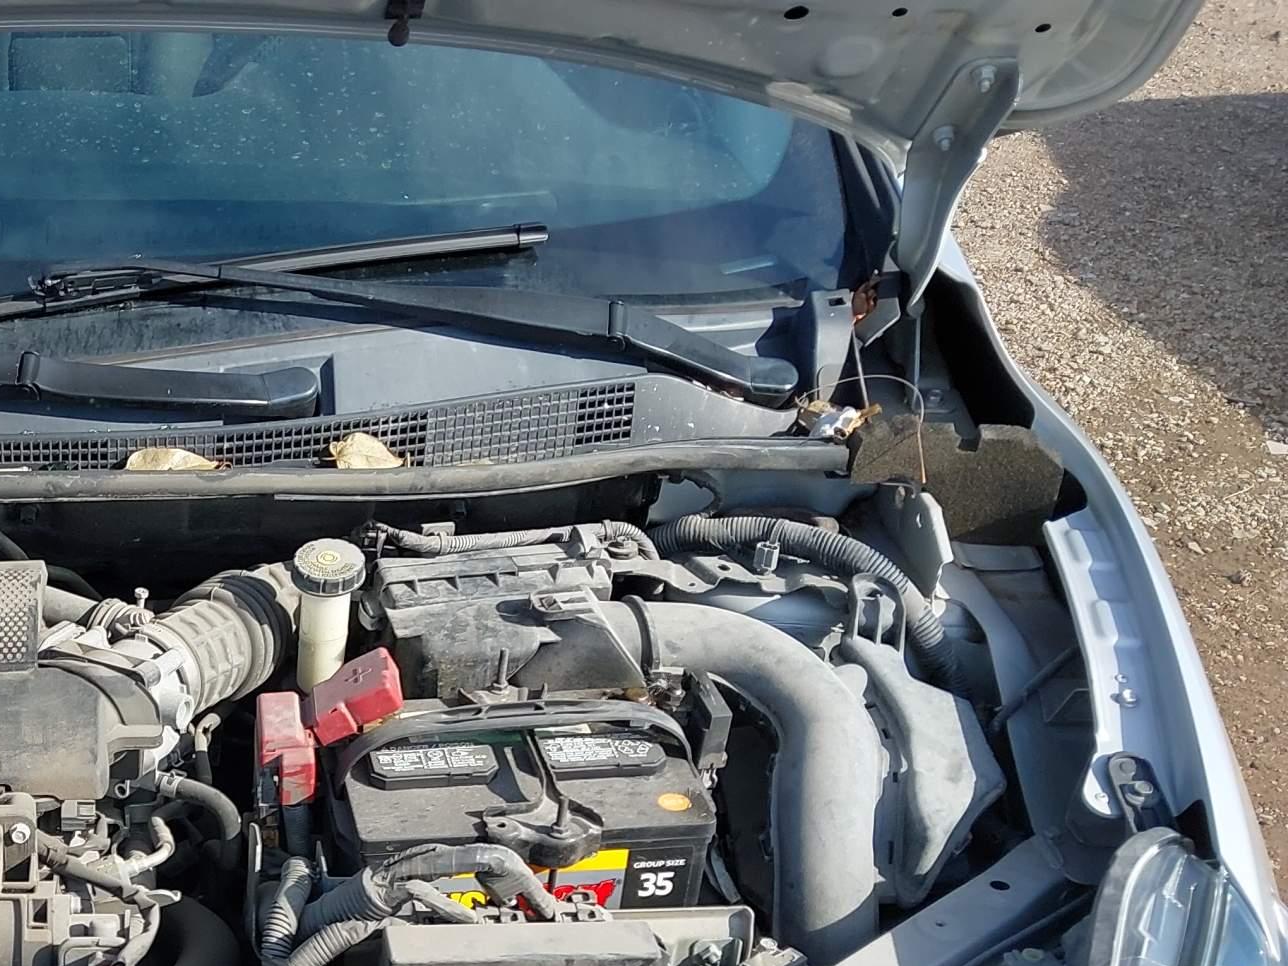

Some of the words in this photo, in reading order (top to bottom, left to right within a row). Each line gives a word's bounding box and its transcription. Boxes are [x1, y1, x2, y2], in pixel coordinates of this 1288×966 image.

[633, 860, 665, 869] GROUP
[665, 859, 687, 867] SIZE
[638, 871, 675, 897] 35
